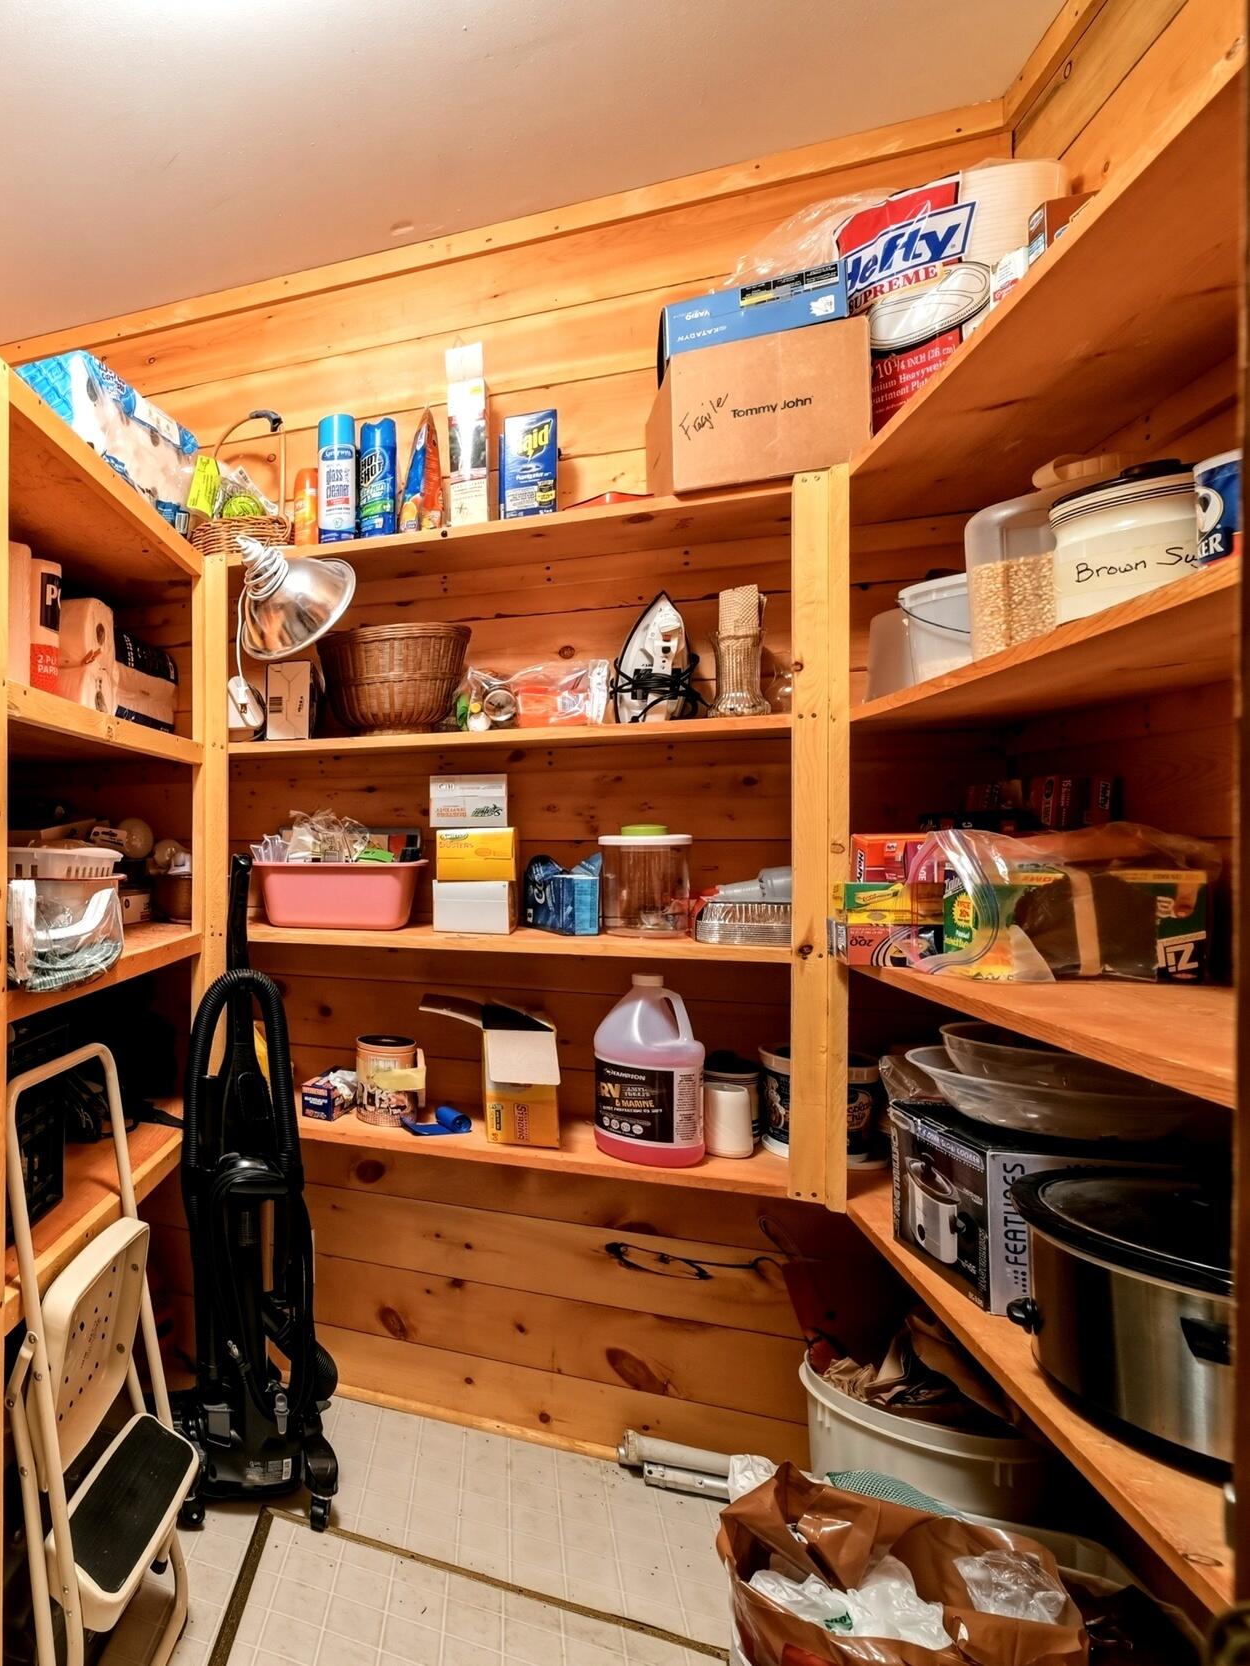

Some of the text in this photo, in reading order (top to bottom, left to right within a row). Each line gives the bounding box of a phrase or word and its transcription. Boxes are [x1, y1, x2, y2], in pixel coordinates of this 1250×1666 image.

[677, 325, 721, 342] KATADYN
[731, 396, 812, 419] Tommy John
[679, 393, 729, 441] Fragile
[326, 468, 344, 485] glass
[326, 483, 350, 498] cleaner
[1075, 560, 1147, 583] Brown
[850, 938, 873, 947] 200
[600, 1082, 621, 1098] RV
[622, 1099, 654, 1108] MARINE
